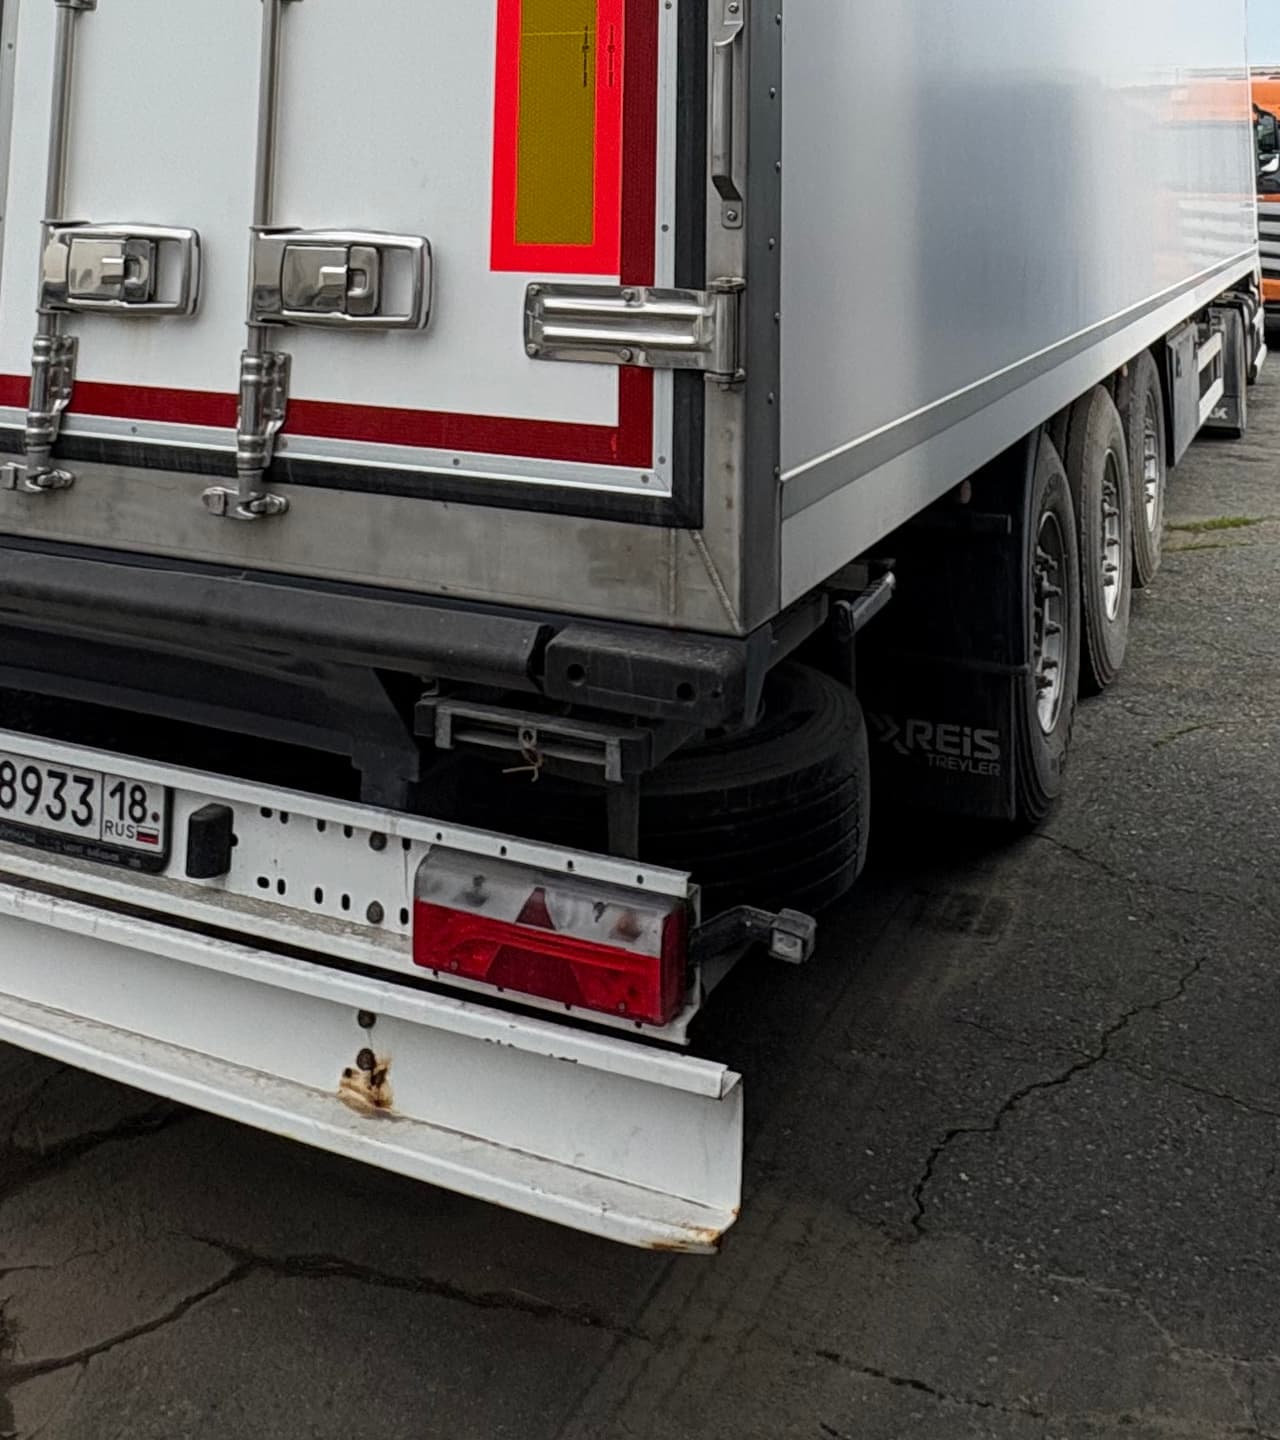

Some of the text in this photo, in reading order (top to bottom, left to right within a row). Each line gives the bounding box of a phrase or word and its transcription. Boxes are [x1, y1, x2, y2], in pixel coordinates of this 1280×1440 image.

[925, 753, 1001, 777] TREYLER
[109, 780, 148, 825] 18
[105, 819, 135, 839] RUS
